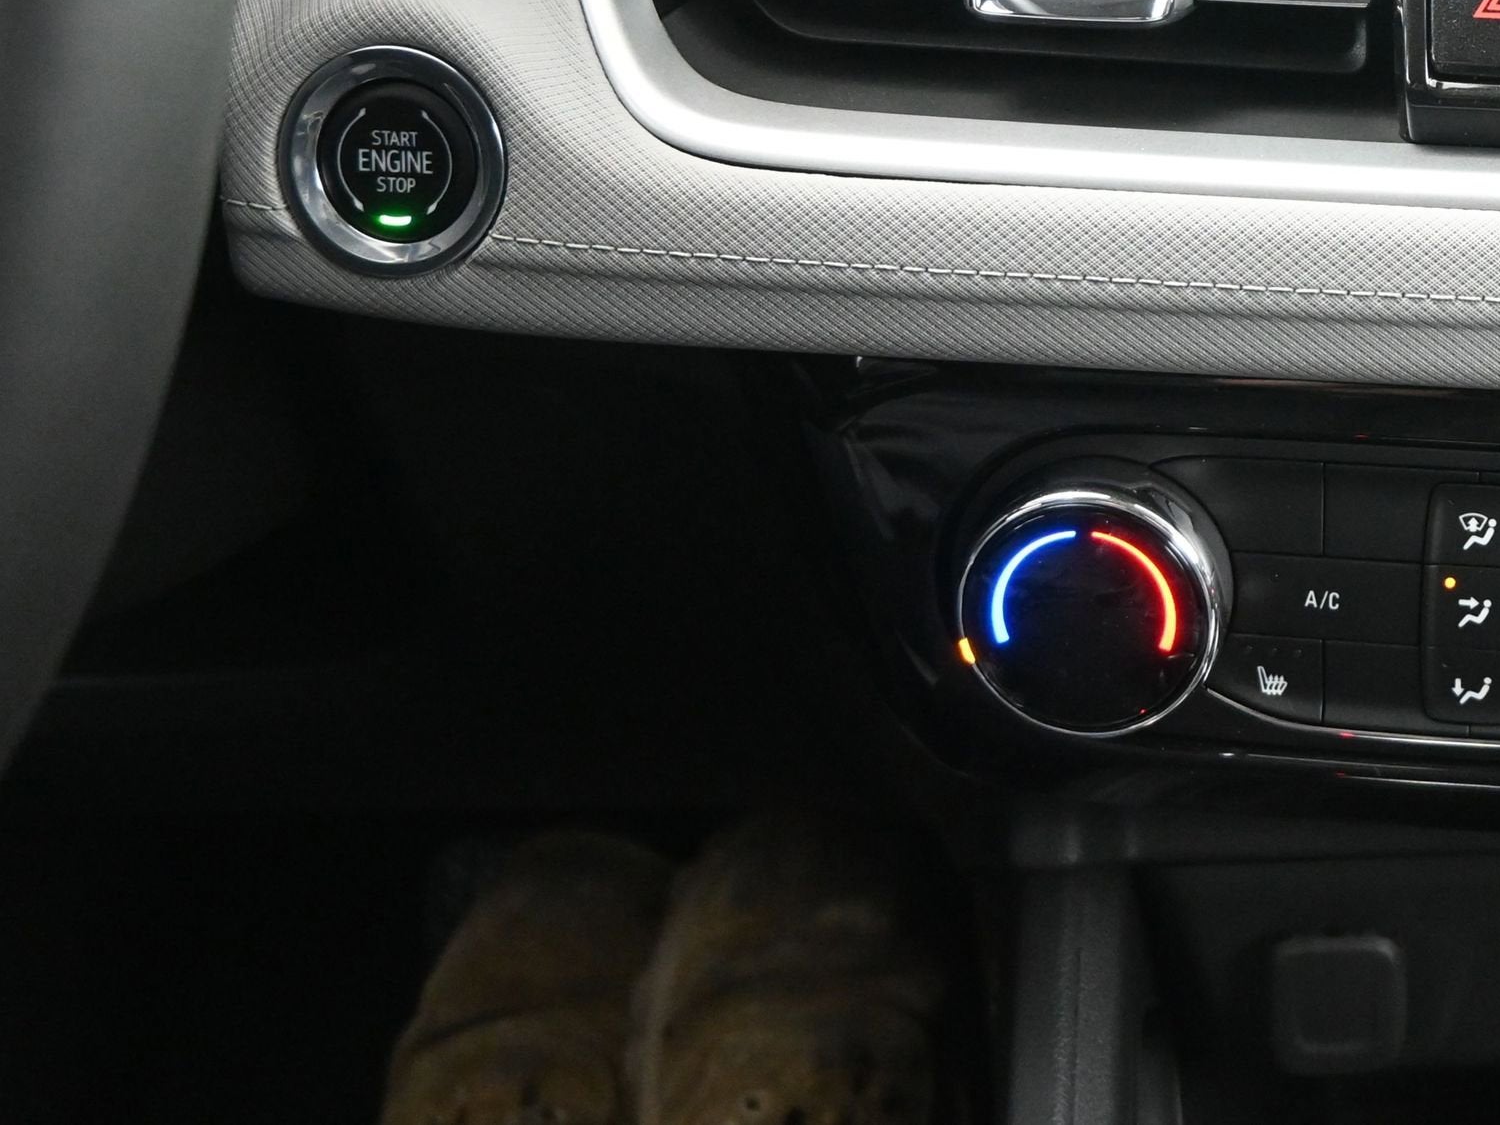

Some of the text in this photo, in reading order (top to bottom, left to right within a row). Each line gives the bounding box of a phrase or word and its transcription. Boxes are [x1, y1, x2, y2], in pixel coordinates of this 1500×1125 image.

[371, 129, 418, 148] START
[358, 149, 434, 175] ENGINE
[376, 177, 416, 193] STOP
[1304, 590, 1341, 610] A/C
